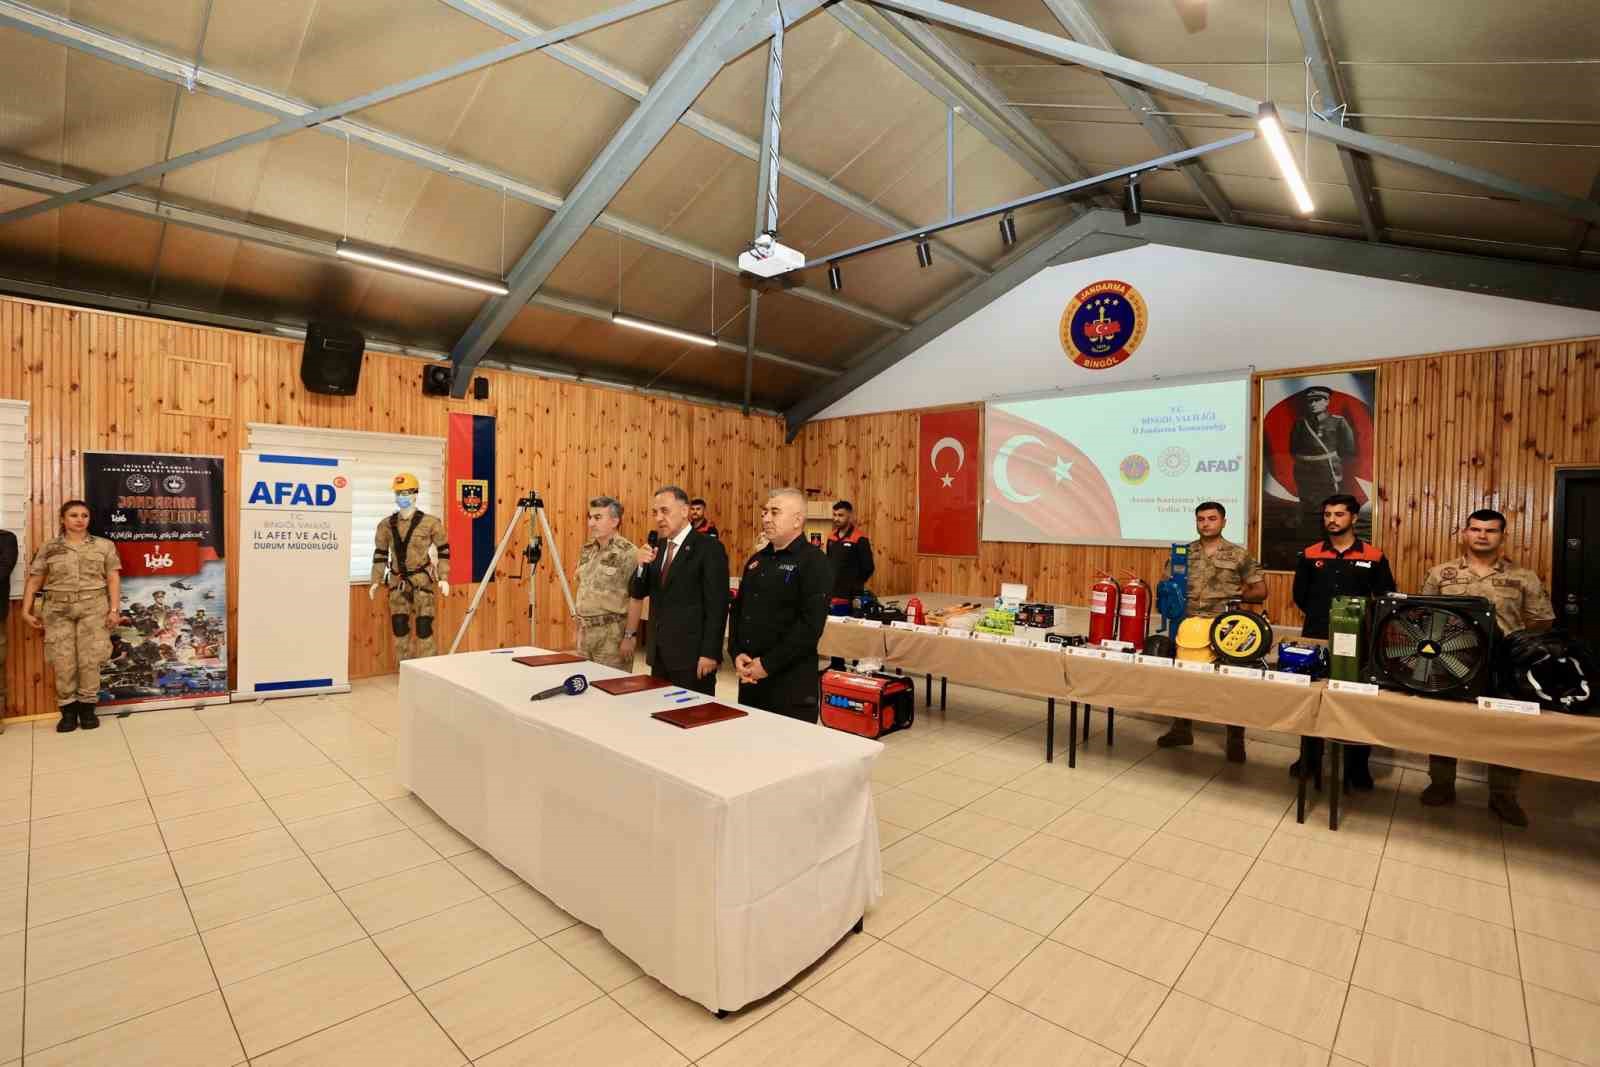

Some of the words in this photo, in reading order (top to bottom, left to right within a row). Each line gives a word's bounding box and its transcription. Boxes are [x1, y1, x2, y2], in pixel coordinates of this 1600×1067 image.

[1081, 283, 1126, 300] JANDARMA
[1195, 460, 1239, 473] AFAD
[248, 481, 337, 506] AFAD
[266, 531, 292, 540] AFET
[296, 531, 310, 540] VE
[312, 530, 337, 541] ACİL
[254, 542, 285, 550] DURUM
